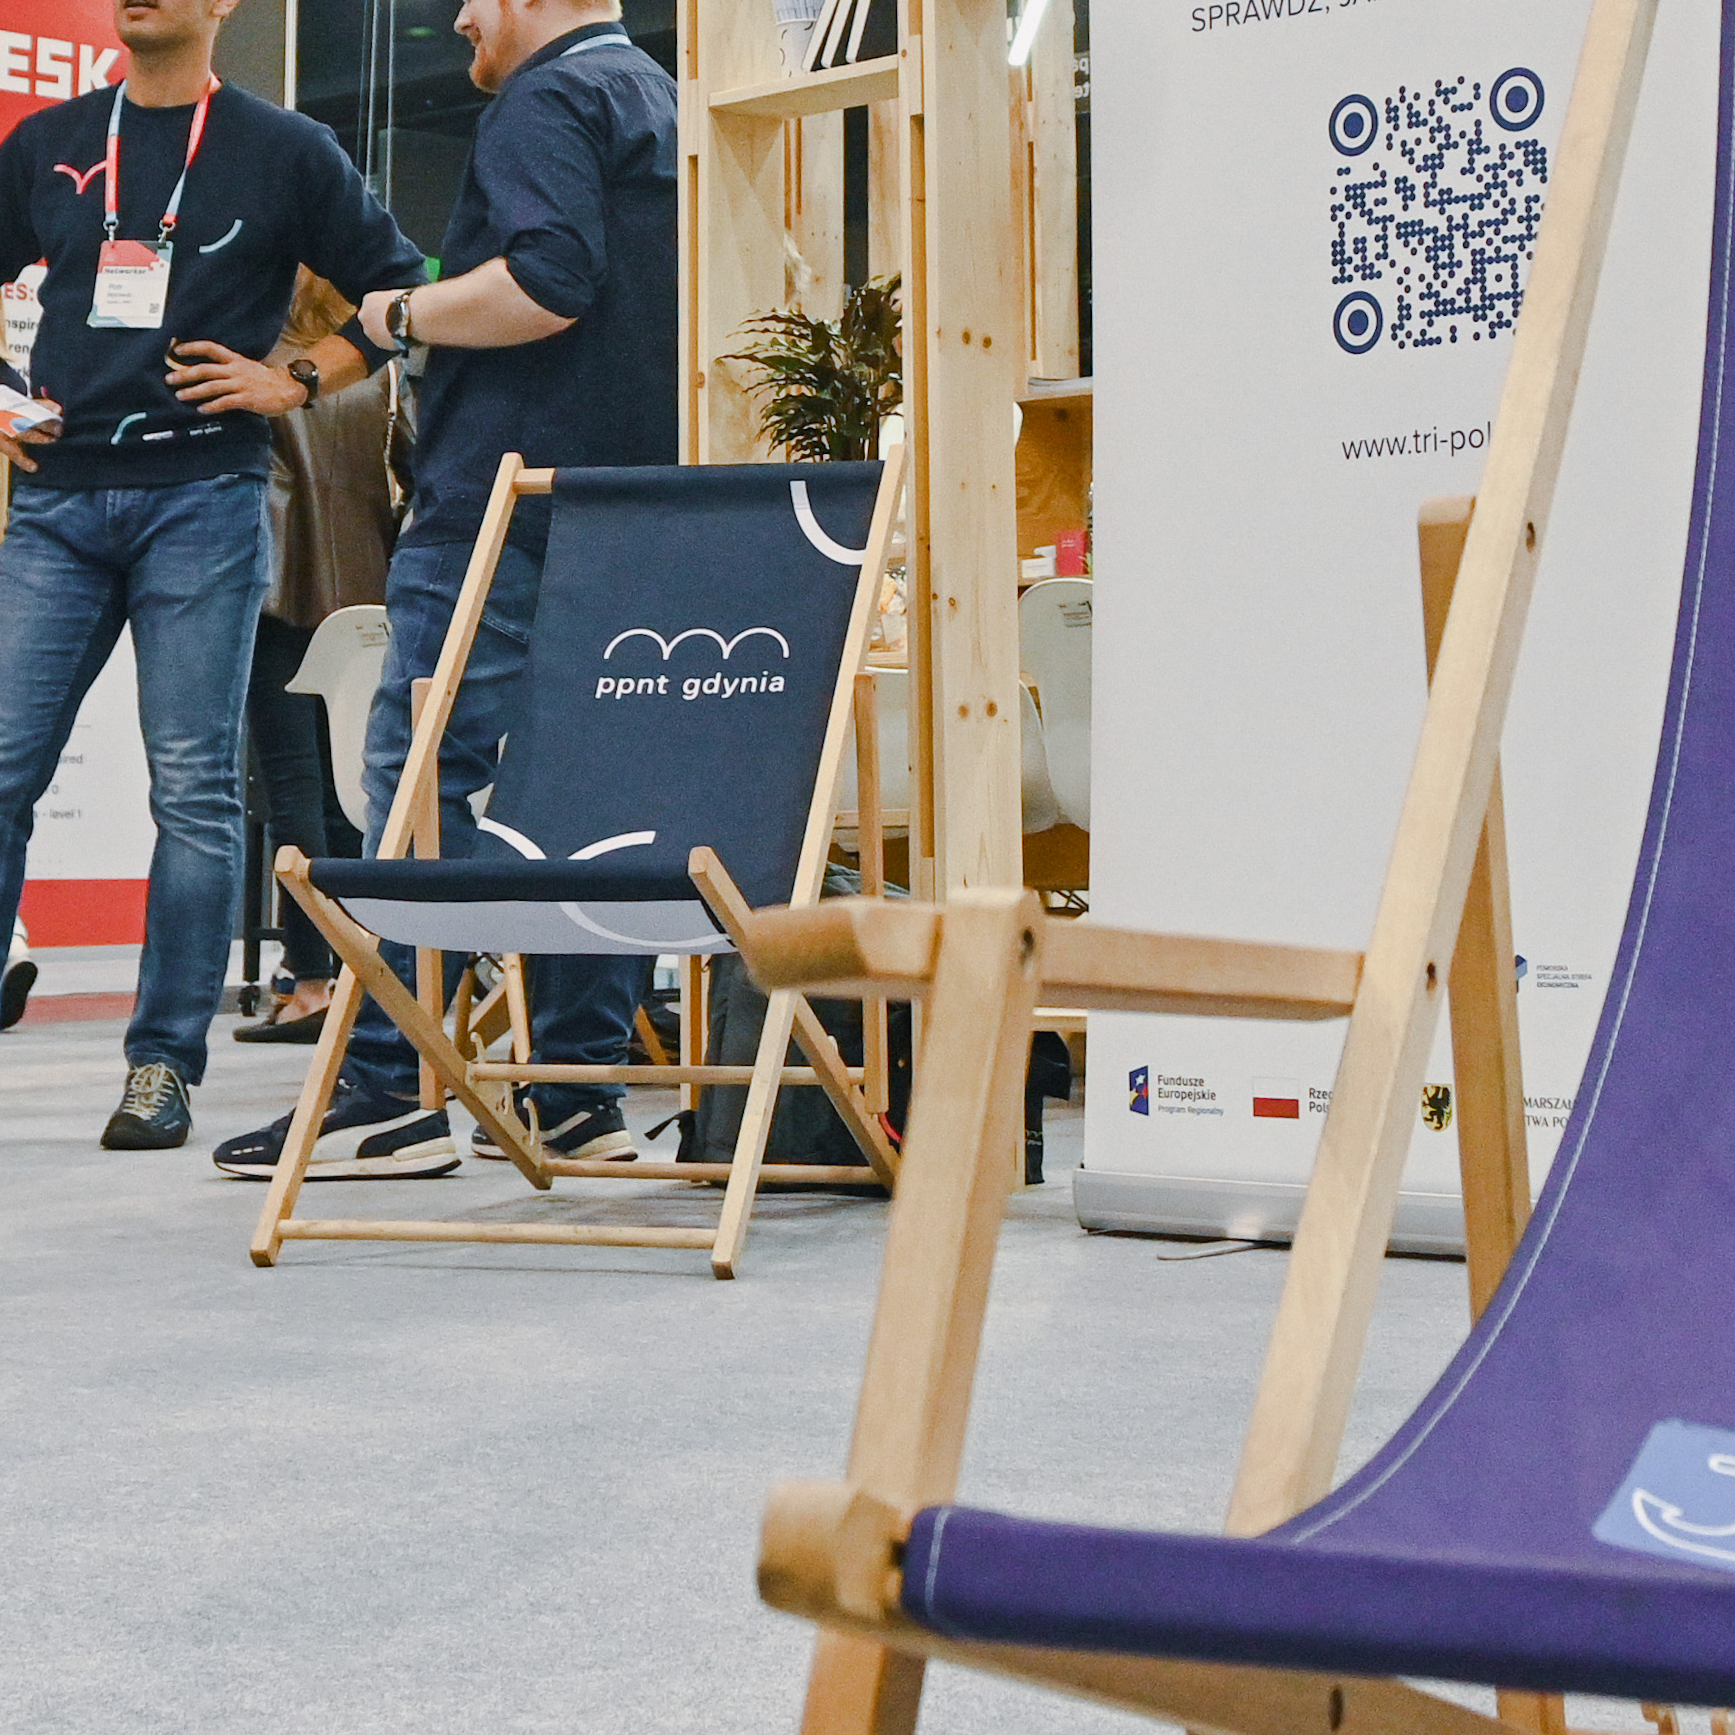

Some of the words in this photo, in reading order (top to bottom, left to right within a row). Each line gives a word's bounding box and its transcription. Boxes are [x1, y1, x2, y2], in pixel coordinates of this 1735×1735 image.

[4, 283, 35, 301] ES:
[1341, 421, 1493, 461] www.tri-pol
[595, 673, 670, 700] ppnt
[681, 670, 786, 701] gdynia
[1157, 1074, 1205, 1087] Fundusze
[1157, 1088, 1216, 1102] Europejskie
[1308, 1087, 1333, 1099] Rzec
[1157, 1104, 1187, 1115] Program
[1187, 1106, 1224, 1116] Regionalny
[1525, 1115, 1549, 1128] TWA
[1552, 1116, 1569, 1129] PO
